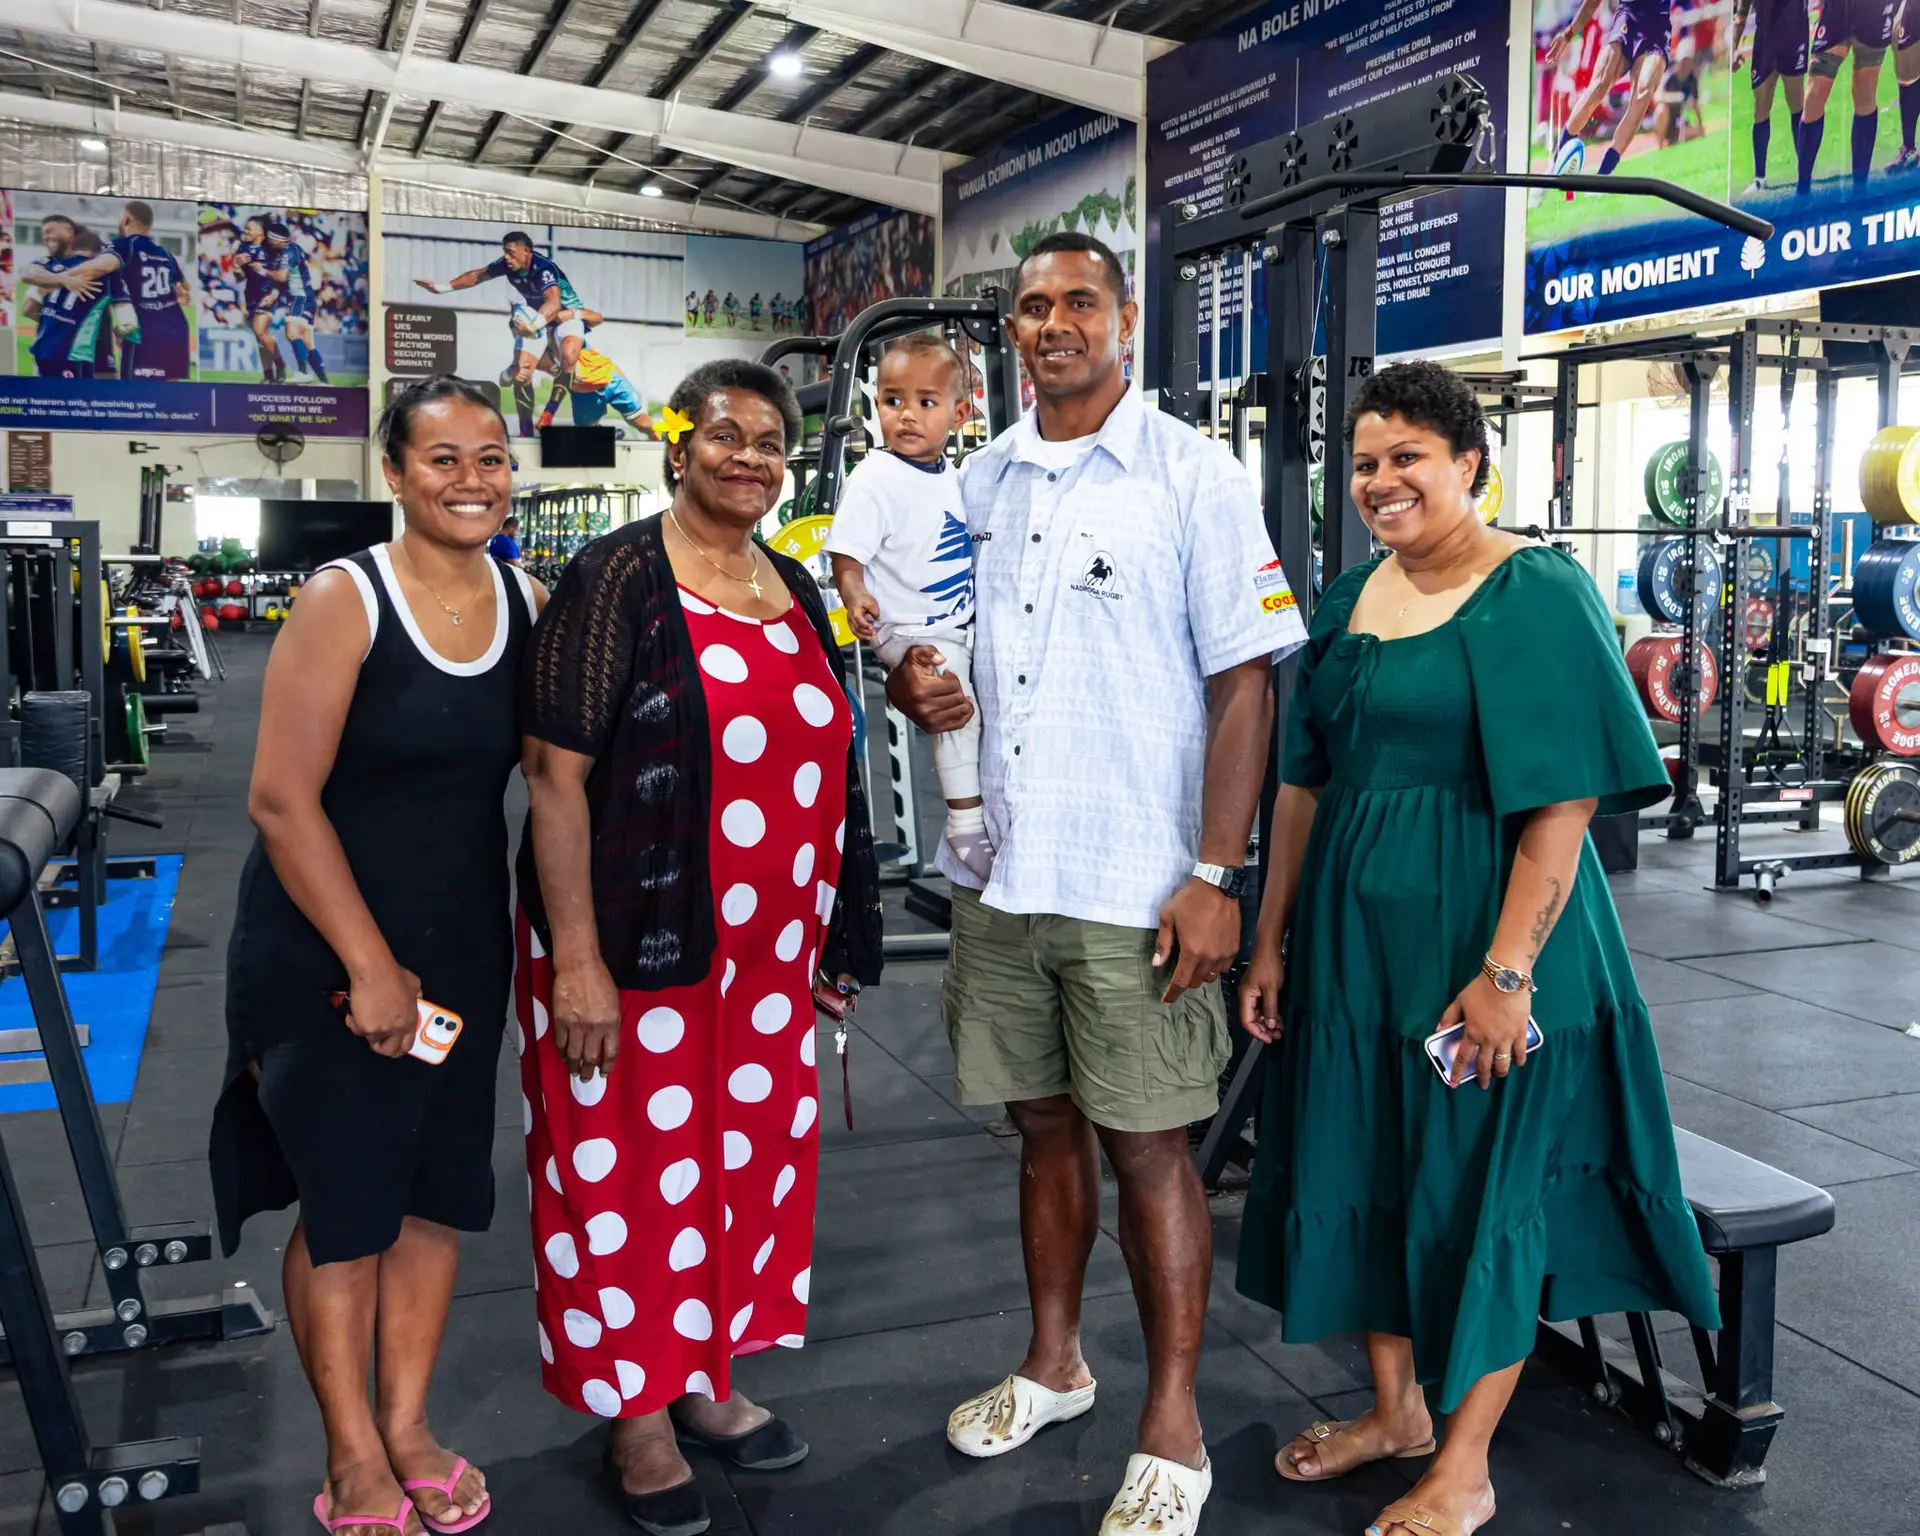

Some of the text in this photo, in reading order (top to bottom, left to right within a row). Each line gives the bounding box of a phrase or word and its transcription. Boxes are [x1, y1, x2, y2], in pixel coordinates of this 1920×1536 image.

[1238, 27, 1258, 53] NA
[1261, 4, 1300, 41] BOLE
[1339, 31, 1354, 45] WILL
[1355, 24, 1369, 37] LIFT
[1369, 19, 1379, 31] UP
[1380, 12, 1395, 26] OUR
[1396, 3, 1414, 18] EYES
[1345, 0, 1453, 54] WHERE OUR HELP COMES FROM
[1365, 35, 1431, 70] PREPARE THE DRUA
[1327, 29, 1476, 98] WE PRESENT OUR CHALLENGE!! BRING IT ON
[1453, 55, 1480, 74] FAMILY
[1268, 72, 1276, 84] SA
[1224, 127, 1240, 141] DRUA
[958, 114, 1120, 200] VANUA DOMONI NA NOQU VANUA
[1202, 145, 1226, 161] NA BOLE
[1395, 199, 1414, 213] HERE
[1395, 212, 1414, 225] HERE
[1399, 223, 1419, 237] YOUR
[1420, 213, 1459, 232] DEFENCES
[1781, 204, 1920, 261] OUR TIM
[1376, 241, 1451, 268] DRUA WILL CONQUER
[1376, 255, 1451, 281] DRUA WILL CONQUER
[1544, 246, 1720, 306] OUR MOMENT
[140, 266, 172, 298] 20
[1393, 275, 1422, 290] HONEST,
[1423, 264, 1470, 284] DISCIPLINED
[1393, 290, 1406, 303] THE
[406, 314, 432, 323] EARLY
[388, 331, 454, 342] CTION WORDS
[388, 340, 432, 349] EACTION
[388, 349, 437, 358] XECUTION
[388, 358, 433, 368] OMINATE
[248, 394, 337, 404] SUCCESS FOLLOWS
[278, 405, 306, 413] WHEN
[308, 406, 322, 414] WE
[299, 415, 313, 423] WE
[1658, 566, 1668, 577] 20
[1902, 567, 1914, 579] 20
[1070, 584, 1124, 601] NADROGA RUGBY
[1881, 662, 1920, 700] IRONED
[1879, 711, 1890, 723] 25
[1864, 769, 1900, 815] IRONEDGE
